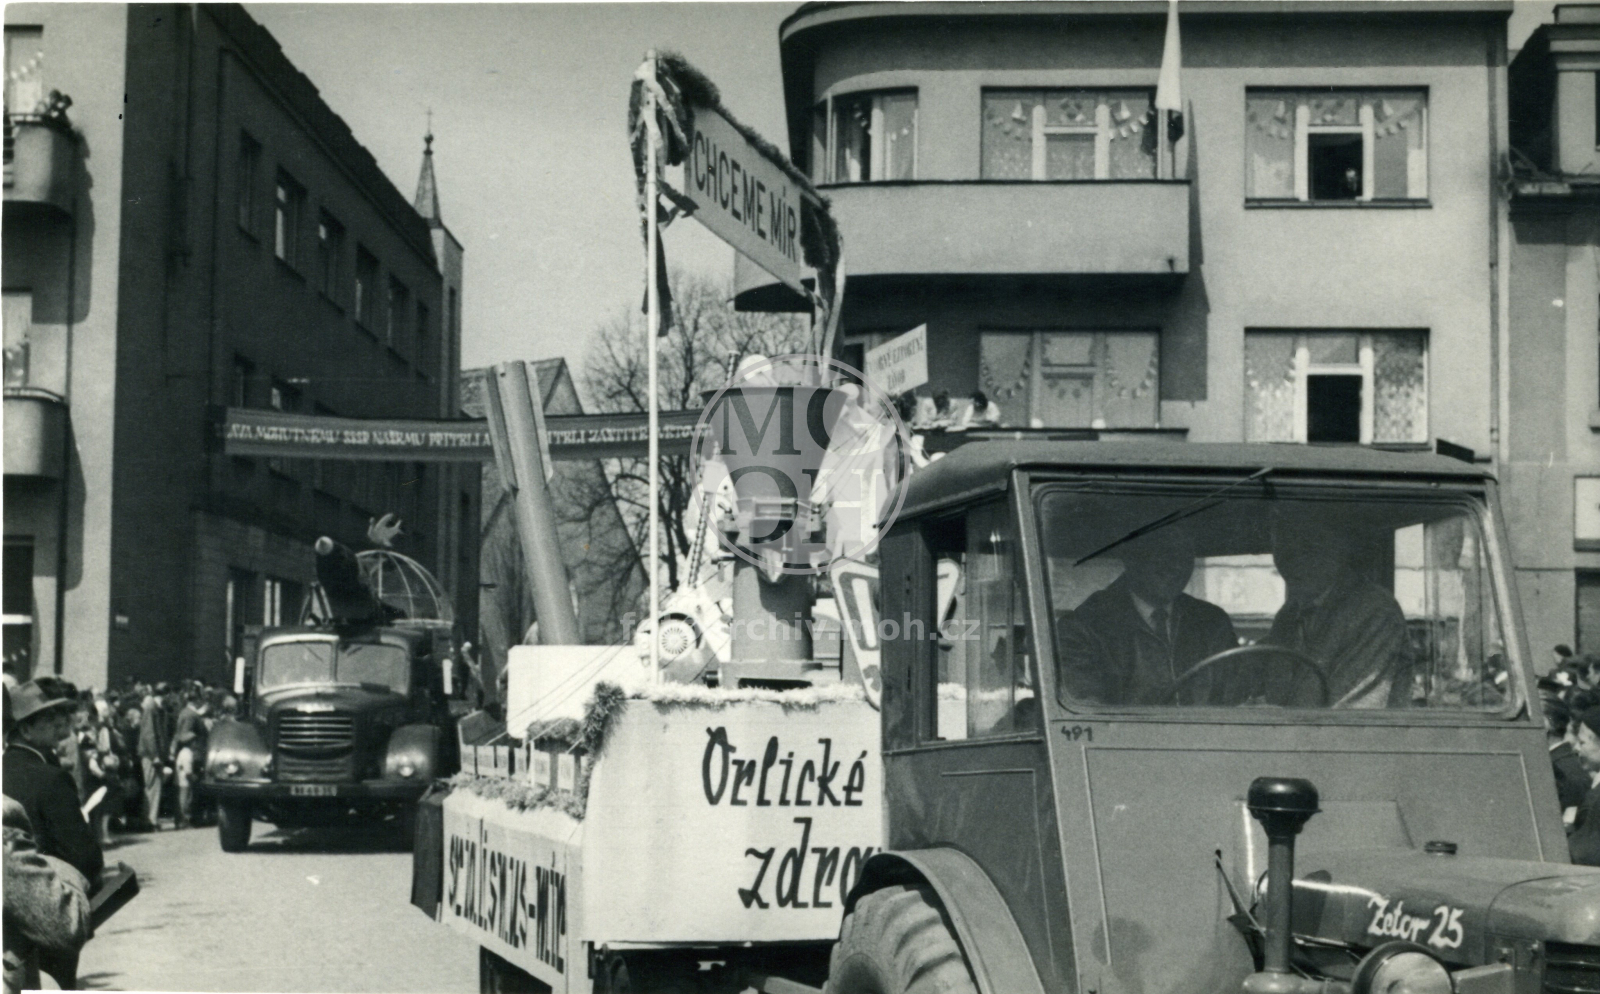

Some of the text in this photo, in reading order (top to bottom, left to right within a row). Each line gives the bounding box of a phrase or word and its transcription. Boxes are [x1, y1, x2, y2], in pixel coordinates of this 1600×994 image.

[694, 131, 797, 263] CHCEME MÍR
[702, 726, 868, 807] Orlické
[1366, 895, 1464, 949] Zetor 25
